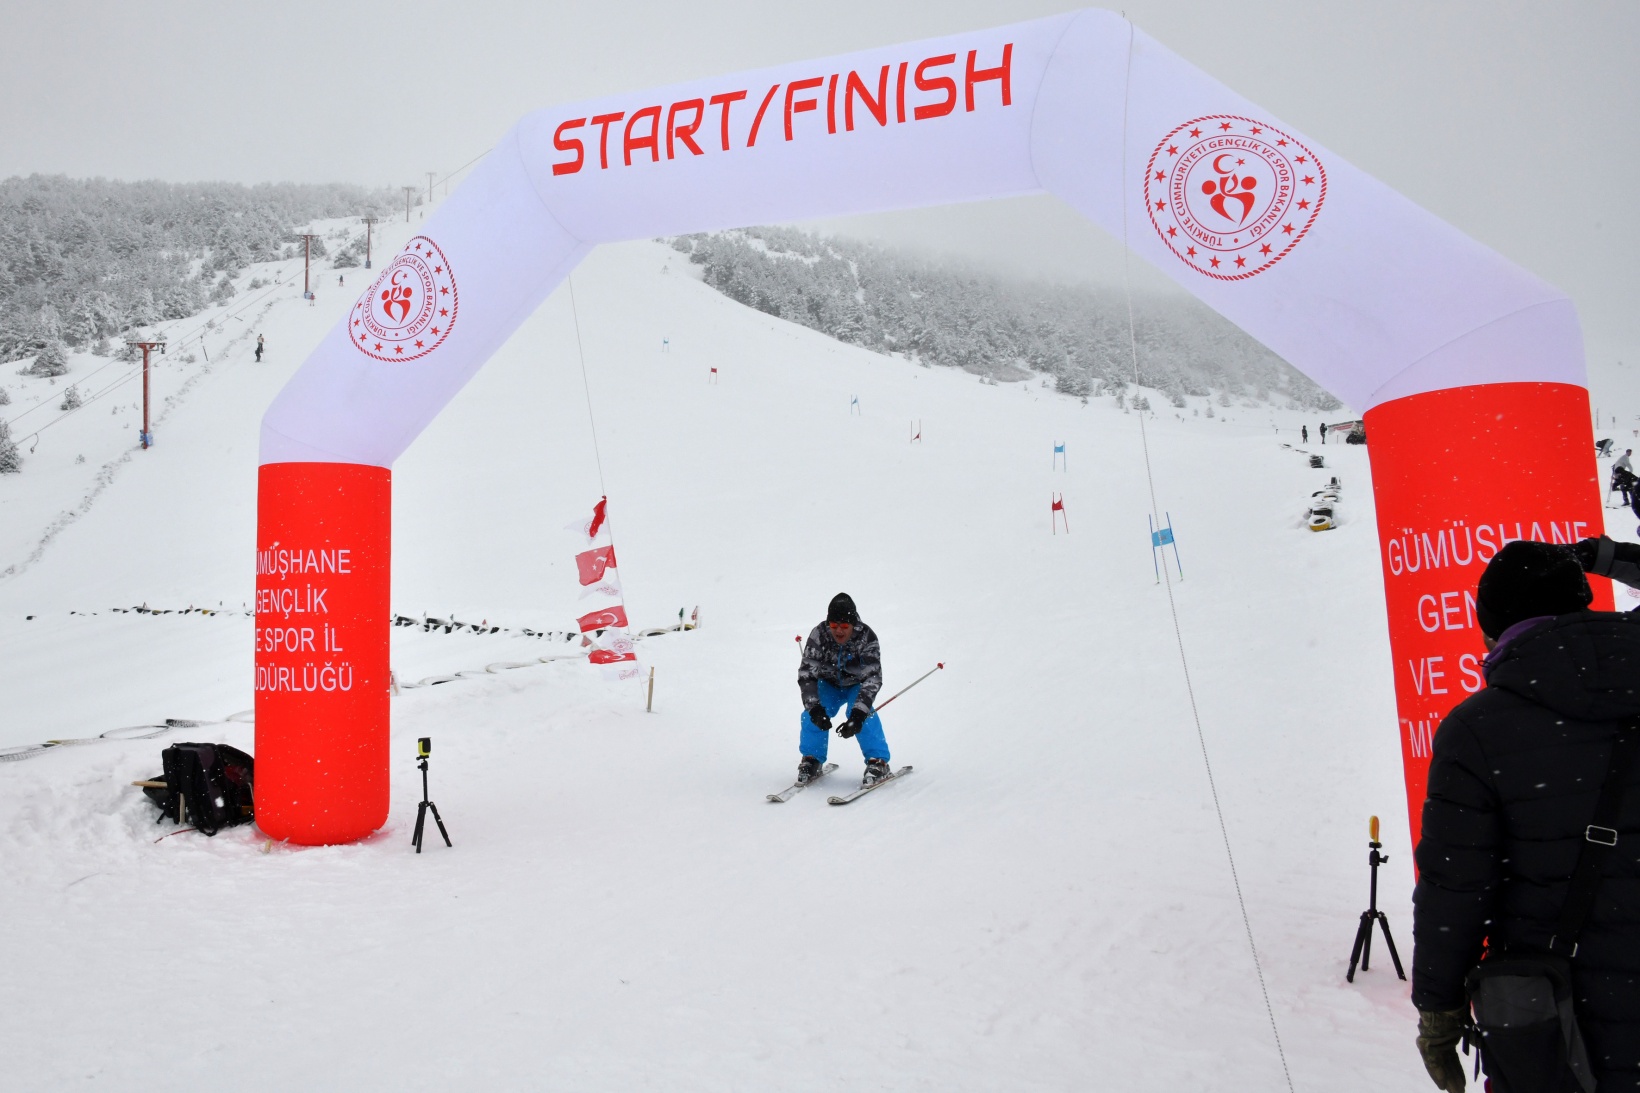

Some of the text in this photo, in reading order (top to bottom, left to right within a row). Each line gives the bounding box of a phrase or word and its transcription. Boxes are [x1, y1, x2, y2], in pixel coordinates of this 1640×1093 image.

[552, 43, 1013, 176] START/FINISH
[1174, 138, 1290, 247] TÜRKİYE CUMHURİYETİ GENÇLİK VE SPOR BAKANLIĞI
[422, 271, 433, 293] SPOR
[407, 295, 433, 335] BAKANLIĞI
[256, 583, 328, 620] GENÇLİK
[1417, 590, 1478, 632] GEN
[256, 622, 343, 652] E SPOR İL
[1408, 652, 1490, 695] VE S
